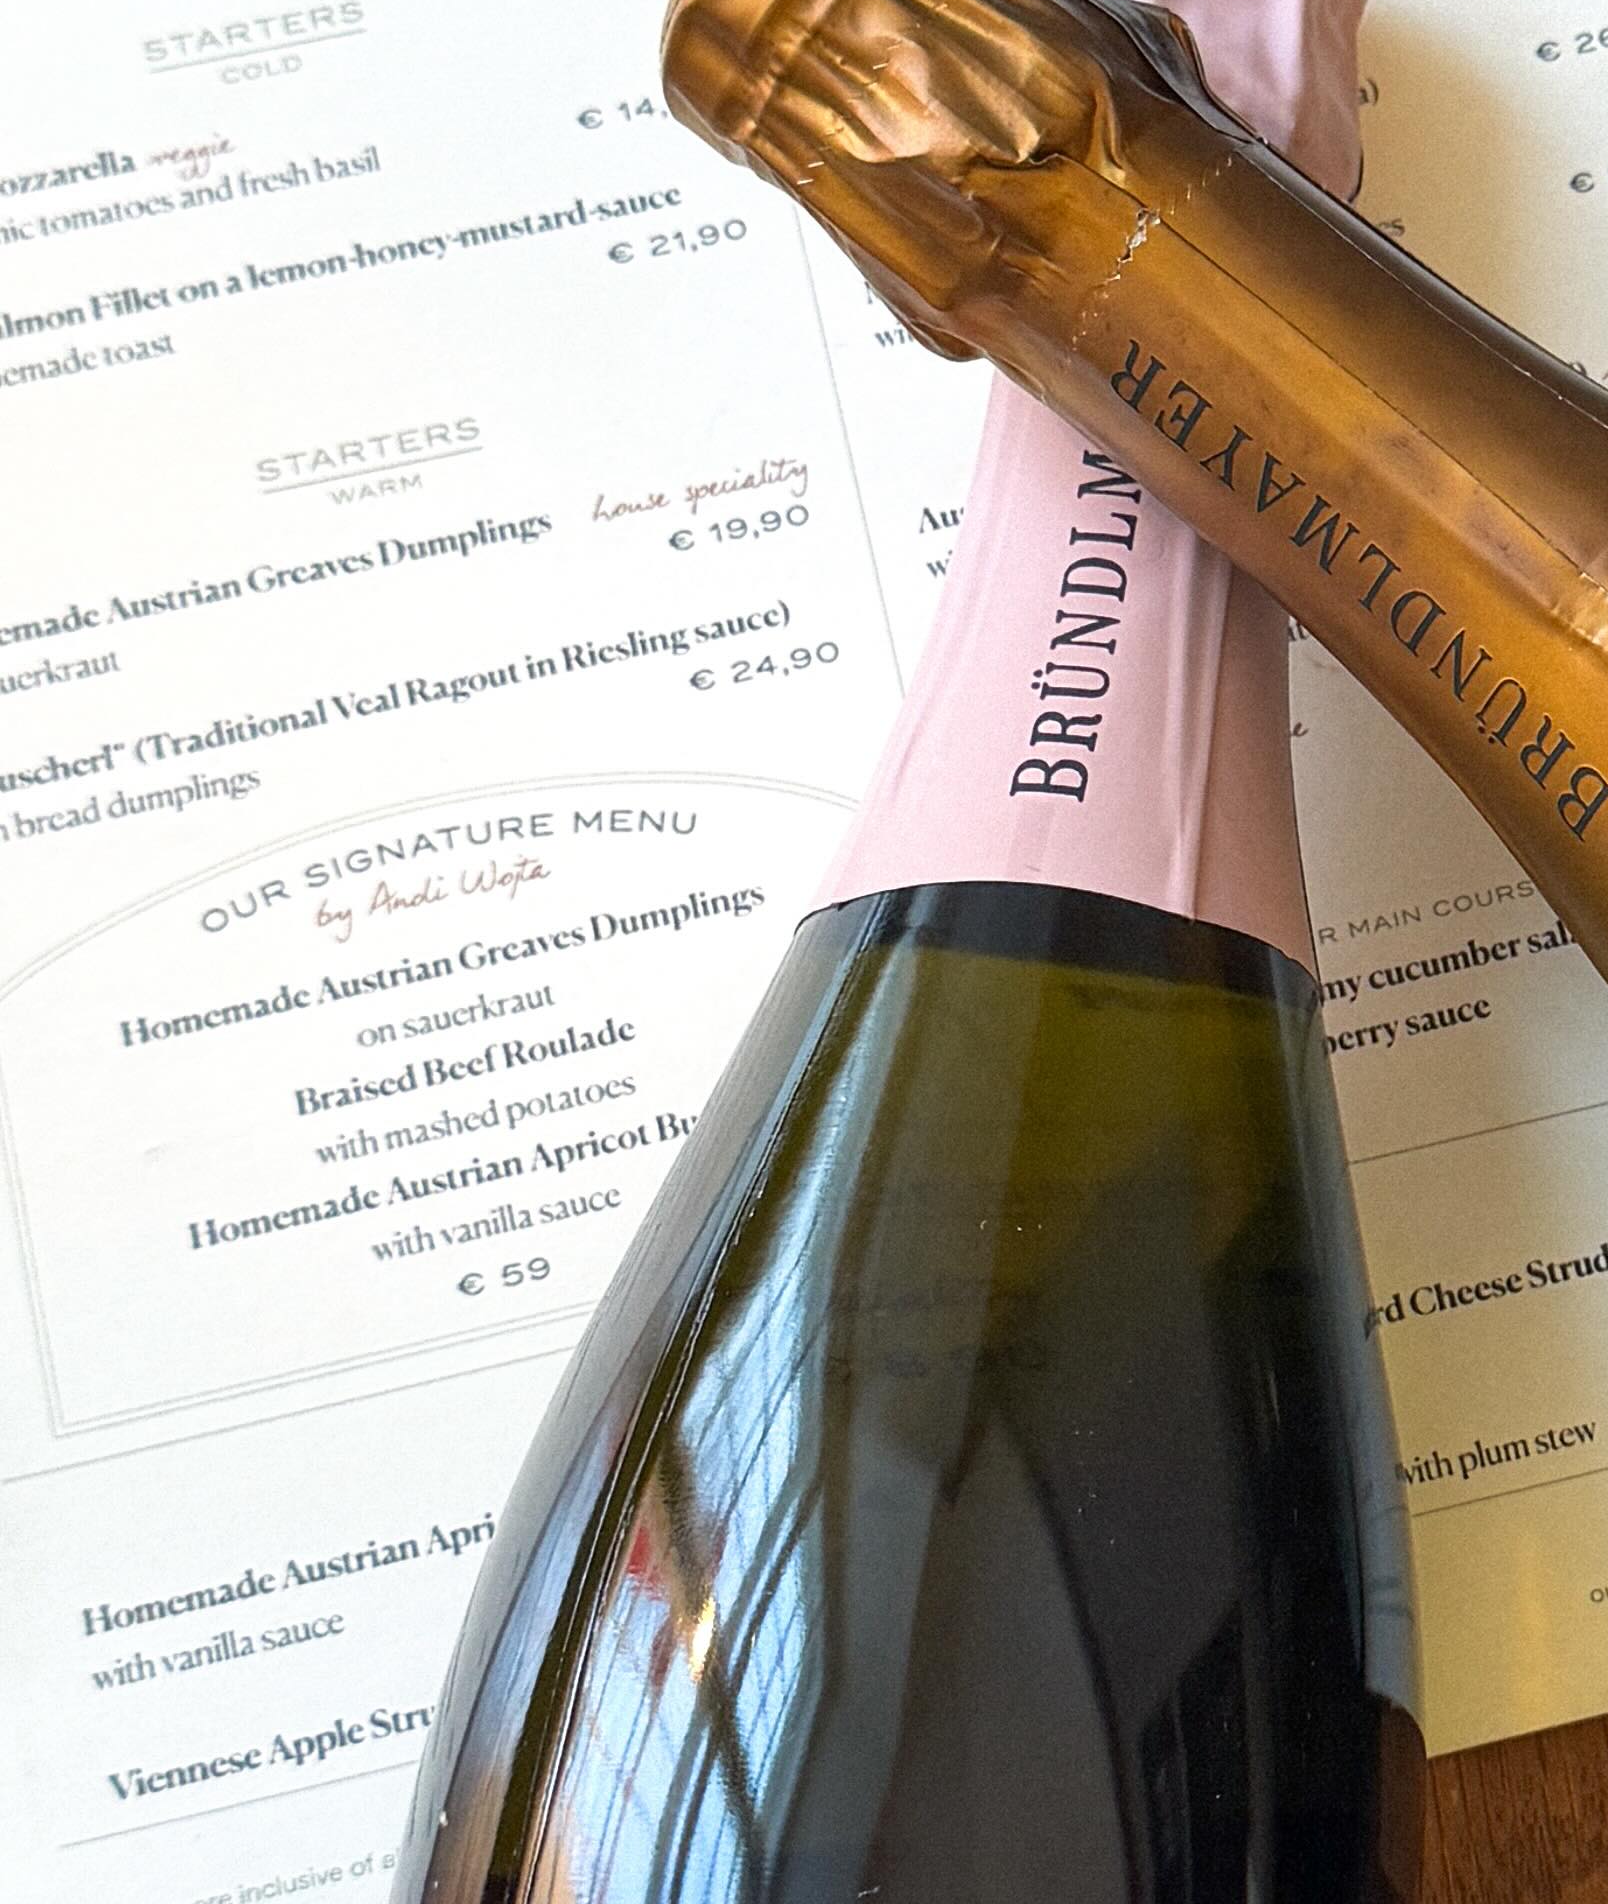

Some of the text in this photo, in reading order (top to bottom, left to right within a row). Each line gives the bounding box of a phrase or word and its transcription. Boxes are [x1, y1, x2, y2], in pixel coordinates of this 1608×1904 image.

[142, 0, 364, 73] STARTERS
[216, 54, 303, 85] COLD
[37, 196, 175, 237] tomatoes
[180, 174, 234, 209] and
[238, 161, 311, 197] fresh
[312, 145, 381, 182] basil
[147, 133, 244, 181] veggie
[89, 287, 171, 321] Fillet
[176, 280, 219, 302] on
[225, 275, 243, 295] a
[245, 188, 681, 290] lemon-honey-mustard-sauce
[102, 334, 175, 366] toast
[649, 219, 747, 257] 21,90
[256, 417, 480, 482] STARTERS
[327, 473, 423, 505] WARM
[709, 504, 809, 543] 19,90
[107, 580, 242, 624] Austrian
[246, 554, 374, 592] Greaves
[377, 516, 552, 566] Dumplings
[592, 493, 670, 522] house
[684, 458, 808, 515] speciality
[1009, 449, 1142, 802] BRÜNDLM
[133, 699, 328, 765] (Traditional
[331, 683, 401, 719] Veal
[405, 664, 520, 706] Ragout
[525, 655, 557, 679] in
[561, 629, 690, 672] Riesling
[694, 600, 790, 643] sauce)
[12, 796, 101, 838] bread
[106, 771, 261, 819] dumplings
[731, 642, 839, 684] 24,90
[200, 809, 697, 933] OUR SIGNATURE MENU
[1348, 905, 1422, 938] MAIN
[1432, 878, 1534, 917] COURS
[315, 899, 352, 944] by
[368, 876, 449, 915] Andi
[120, 889, 765, 1047] Homemade Austrian Greaves Dumplings
[1320, 917, 1573, 1002] my cucumber sal
[356, 985, 555, 1047] on sauerkraut
[1405, 1000, 1491, 1036] sauce
[295, 1018, 635, 1116] Braised Beef Roulade
[315, 1128, 379, 1164] with
[384, 1098, 500, 1151] mashed
[505, 1076, 636, 1130] potatoes
[188, 1185, 380, 1250] Homemade
[388, 1157, 523, 1205] Austrian
[531, 1125, 651, 1173] Apricot
[371, 1189, 621, 1261] with vanilla sauce
[501, 1257, 550, 1287] 59
[1409, 1274, 1523, 1315] Cheese
[1457, 1439, 1530, 1480] plum
[1534, 1422, 1595, 1455] stew
[82, 1513, 500, 1637] Homemade Austrian Apri
[91, 1614, 344, 1690] with vanilla sauce
[108, 1706, 438, 1800] Viennese Apple Str
[349, 1852, 373, 1879] of
